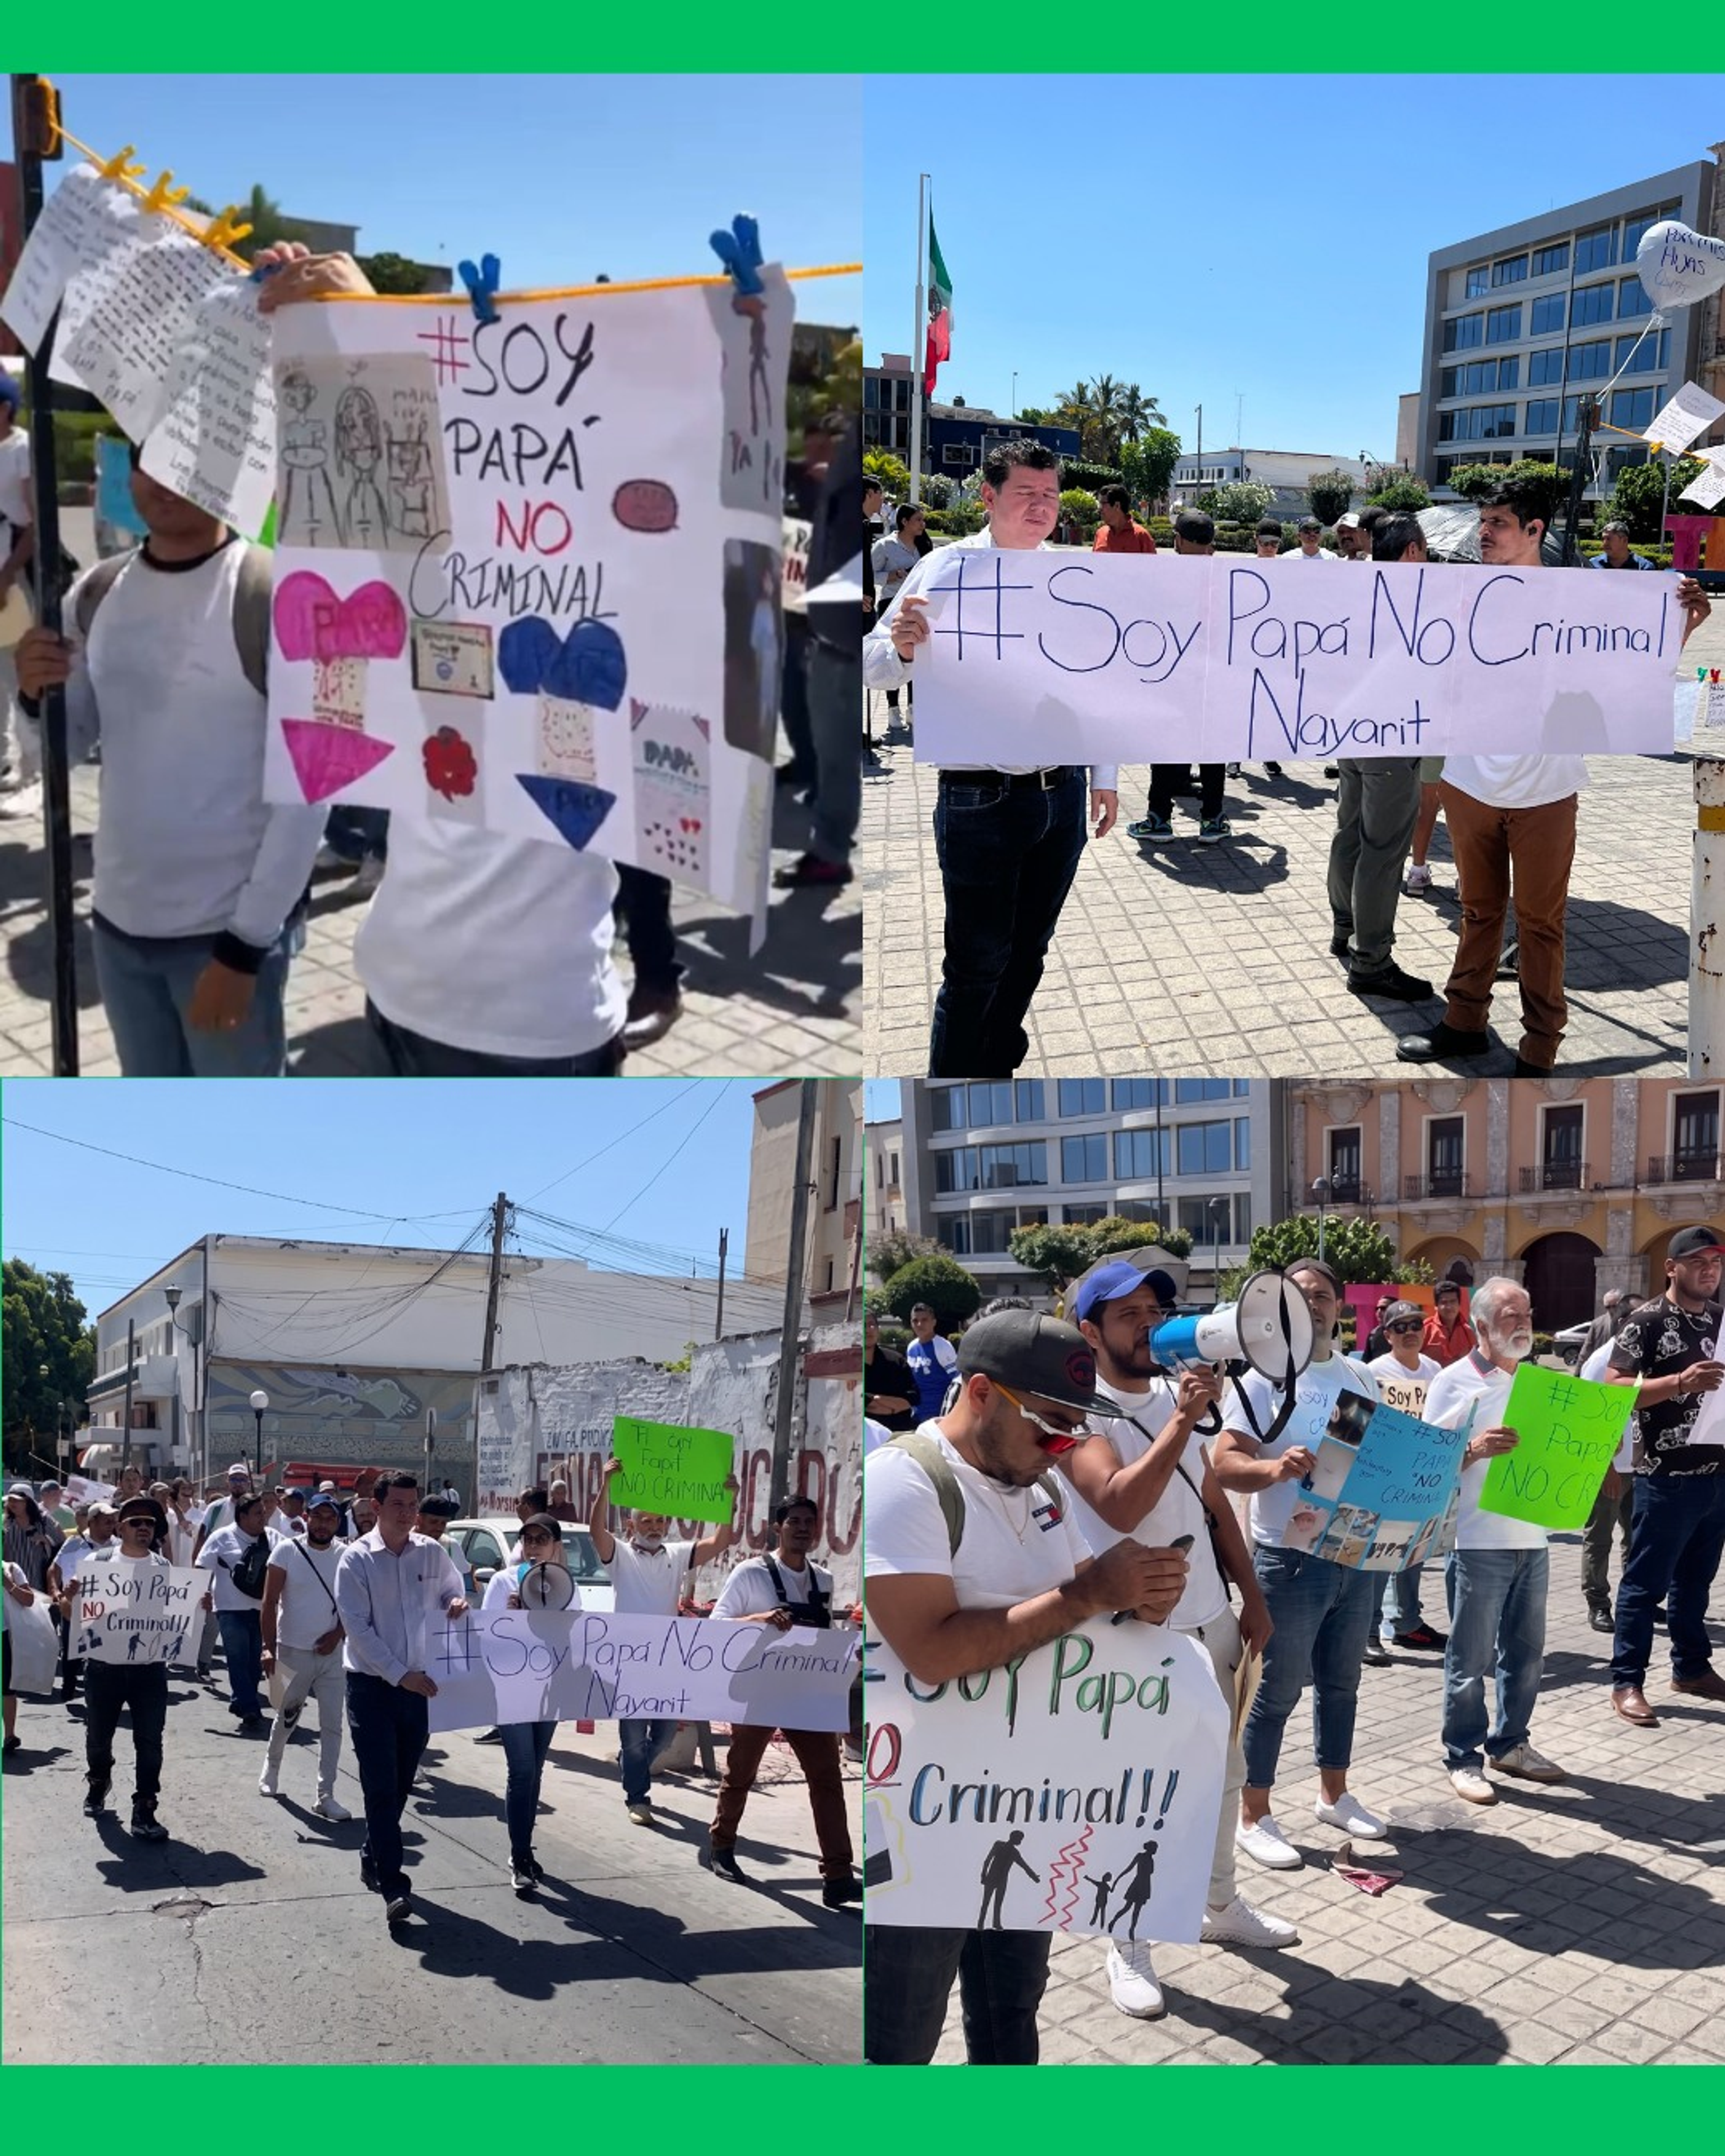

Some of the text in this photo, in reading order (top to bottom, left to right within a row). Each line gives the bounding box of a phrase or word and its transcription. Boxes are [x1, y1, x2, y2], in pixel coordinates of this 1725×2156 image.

[417, 314, 593, 406] #SOY
[444, 415, 602, 491] PAPÁ
[495, 500, 573, 555] NO
[409, 530, 619, 619] CRIMINAL
[1228, 568, 1350, 679] Papá
[1369, 568, 1455, 666] No
[1468, 574, 1668, 666] Criminal
[1247, 667, 1430, 759] Nayarit
[1387, 1386, 1411, 1407] Soy
[1548, 1380, 1579, 1413] #
[1411, 1423, 1432, 1440] #
[620, 1472, 646, 1496] NO
[1499, 1459, 1549, 1502] NO
[80, 1573, 192, 1606] # Soy Papá
[83, 1601, 105, 1618] NO
[580, 1617, 652, 1676] Papá
[659, 1620, 713, 1670] No
[721, 1626, 855, 1675] Criminal
[585, 1670, 691, 1718] Nayarit
[1049, 1634, 1175, 1740] Papá
[909, 1763, 1179, 1830] Criminal!!
